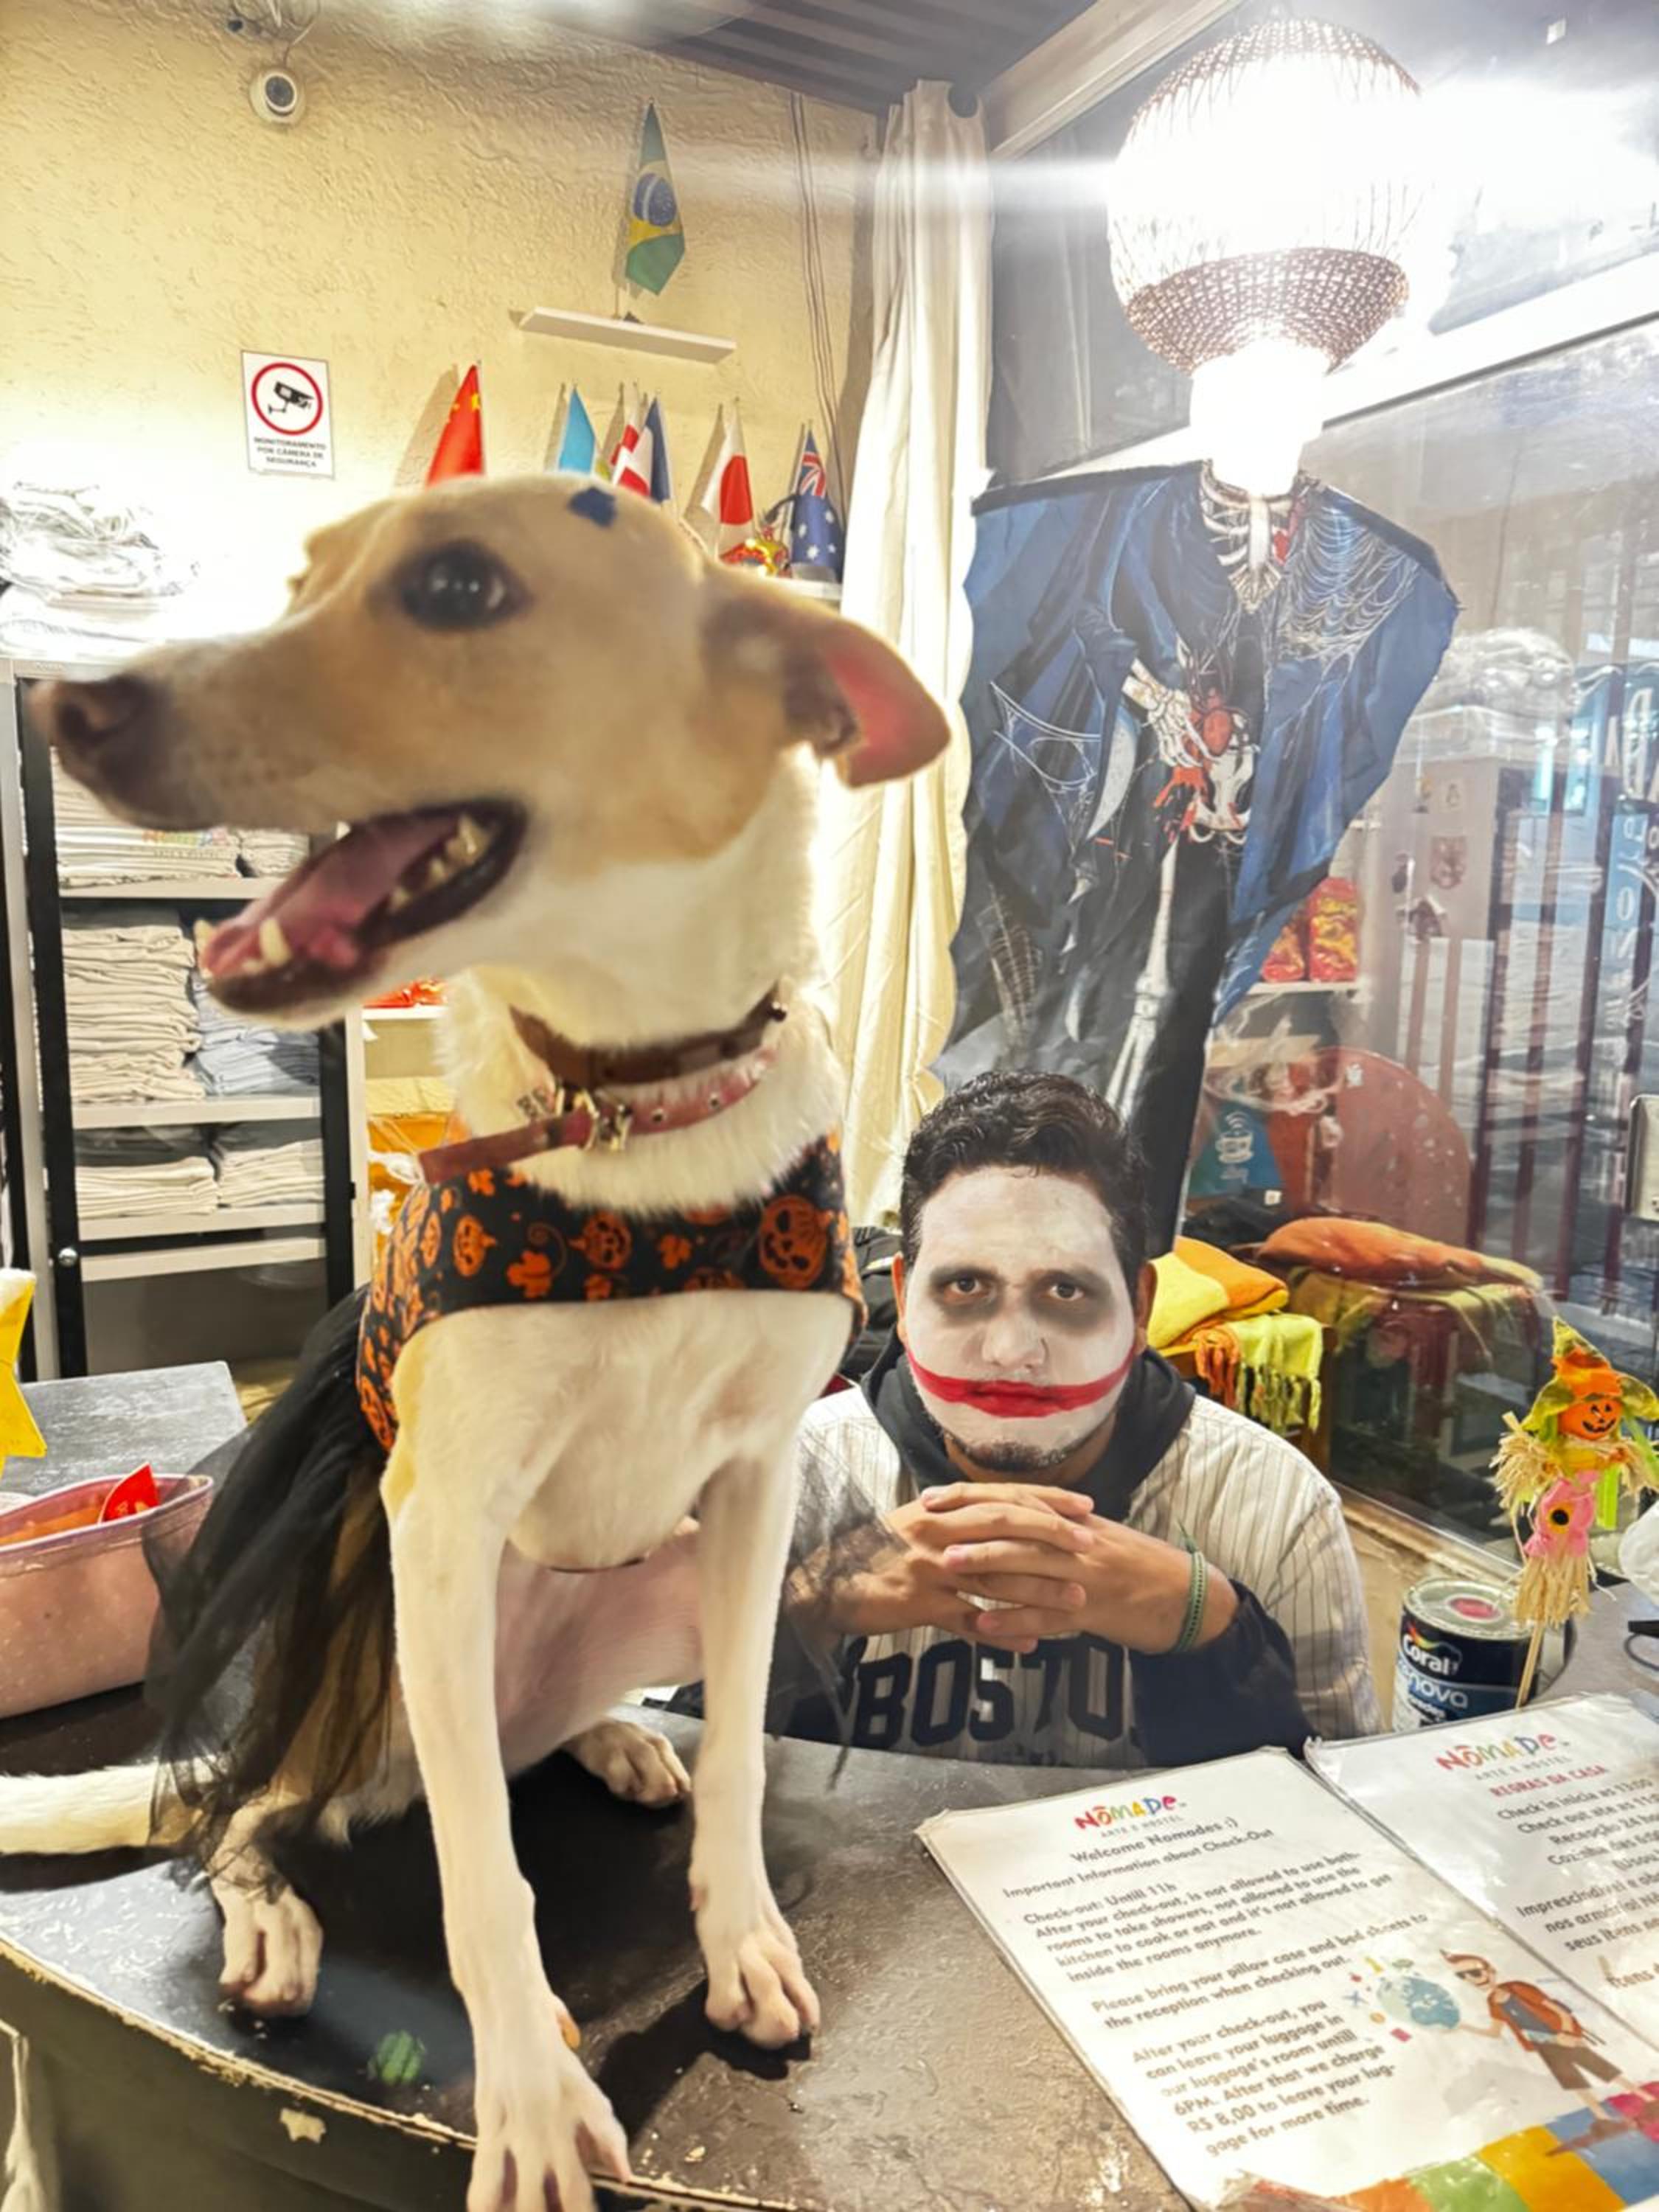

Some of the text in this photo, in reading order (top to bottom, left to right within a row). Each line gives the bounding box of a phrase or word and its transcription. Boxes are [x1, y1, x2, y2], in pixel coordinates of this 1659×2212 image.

[1403, 1635, 1450, 1676] Coral
[1489, 1777, 1549, 1797] REGRAS
[1569, 1764, 1608, 1781] CASA
[1003, 1829, 1274, 1898] Important Information about Check-Out
[1070, 1842, 1146, 1863] Welcome
[1145, 1823, 1222, 1846] Nomades
[1036, 1924, 1073, 1938] After
[1077, 1916, 1108, 1931] your
[1113, 1897, 1188, 1921] check-out,
[1186, 1892, 1202, 1902] is
[1203, 1885, 1228, 1898] not
[1230, 1870, 1282, 1891] allowed
[1300, 1861, 1325, 1872] use
[1046, 1867, 1360, 1952] rooms to take showers, not allowed to use the
[1148, 1882, 1177, 1895] 11h
[1056, 1874, 1392, 1967] kitchen to cook or eat and it's not allowed to get
[1564, 1935, 1602, 1951] seus
[1067, 1928, 1262, 1982] inside the rooms anymore.
[1091, 1994, 1144, 2012] Please
[1144, 1982, 1190, 2000] bring
[1190, 1972, 1223, 1989] your
[1226, 1960, 1269, 1979] pillow
[1273, 1950, 1307, 1964] case
[1308, 1938, 1337, 1954] and
[1334, 1930, 1366, 1946] bed
[1410, 1914, 1428, 1924] to
[1105, 2017, 1133, 2029] the
[1135, 1996, 1209, 2021] reception
[1211, 1983, 1253, 1999] when
[1254, 1964, 1322, 1988] checking
[1133, 2001, 1327, 2063] After your check-out, you
[1146, 2015, 1345, 2079] can leave your luggage in
[1189, 2057, 1271, 2088] luggage's
[1272, 2045, 1315, 2064] room
[1215, 2104, 1256, 2126] 8,00
[1257, 2101, 1278, 2112] to
[1277, 2086, 1325, 2106] leave
[1325, 2074, 1361, 2095] your
[1360, 2065, 1394, 2079] lug-
[1223, 2082, 1264, 2101] After
[1266, 2069, 1302, 2087] that
[1304, 2062, 1329, 2074] we
[1331, 2045, 1385, 2067] charge
[1206, 2097, 1368, 2157] gage for more time.
